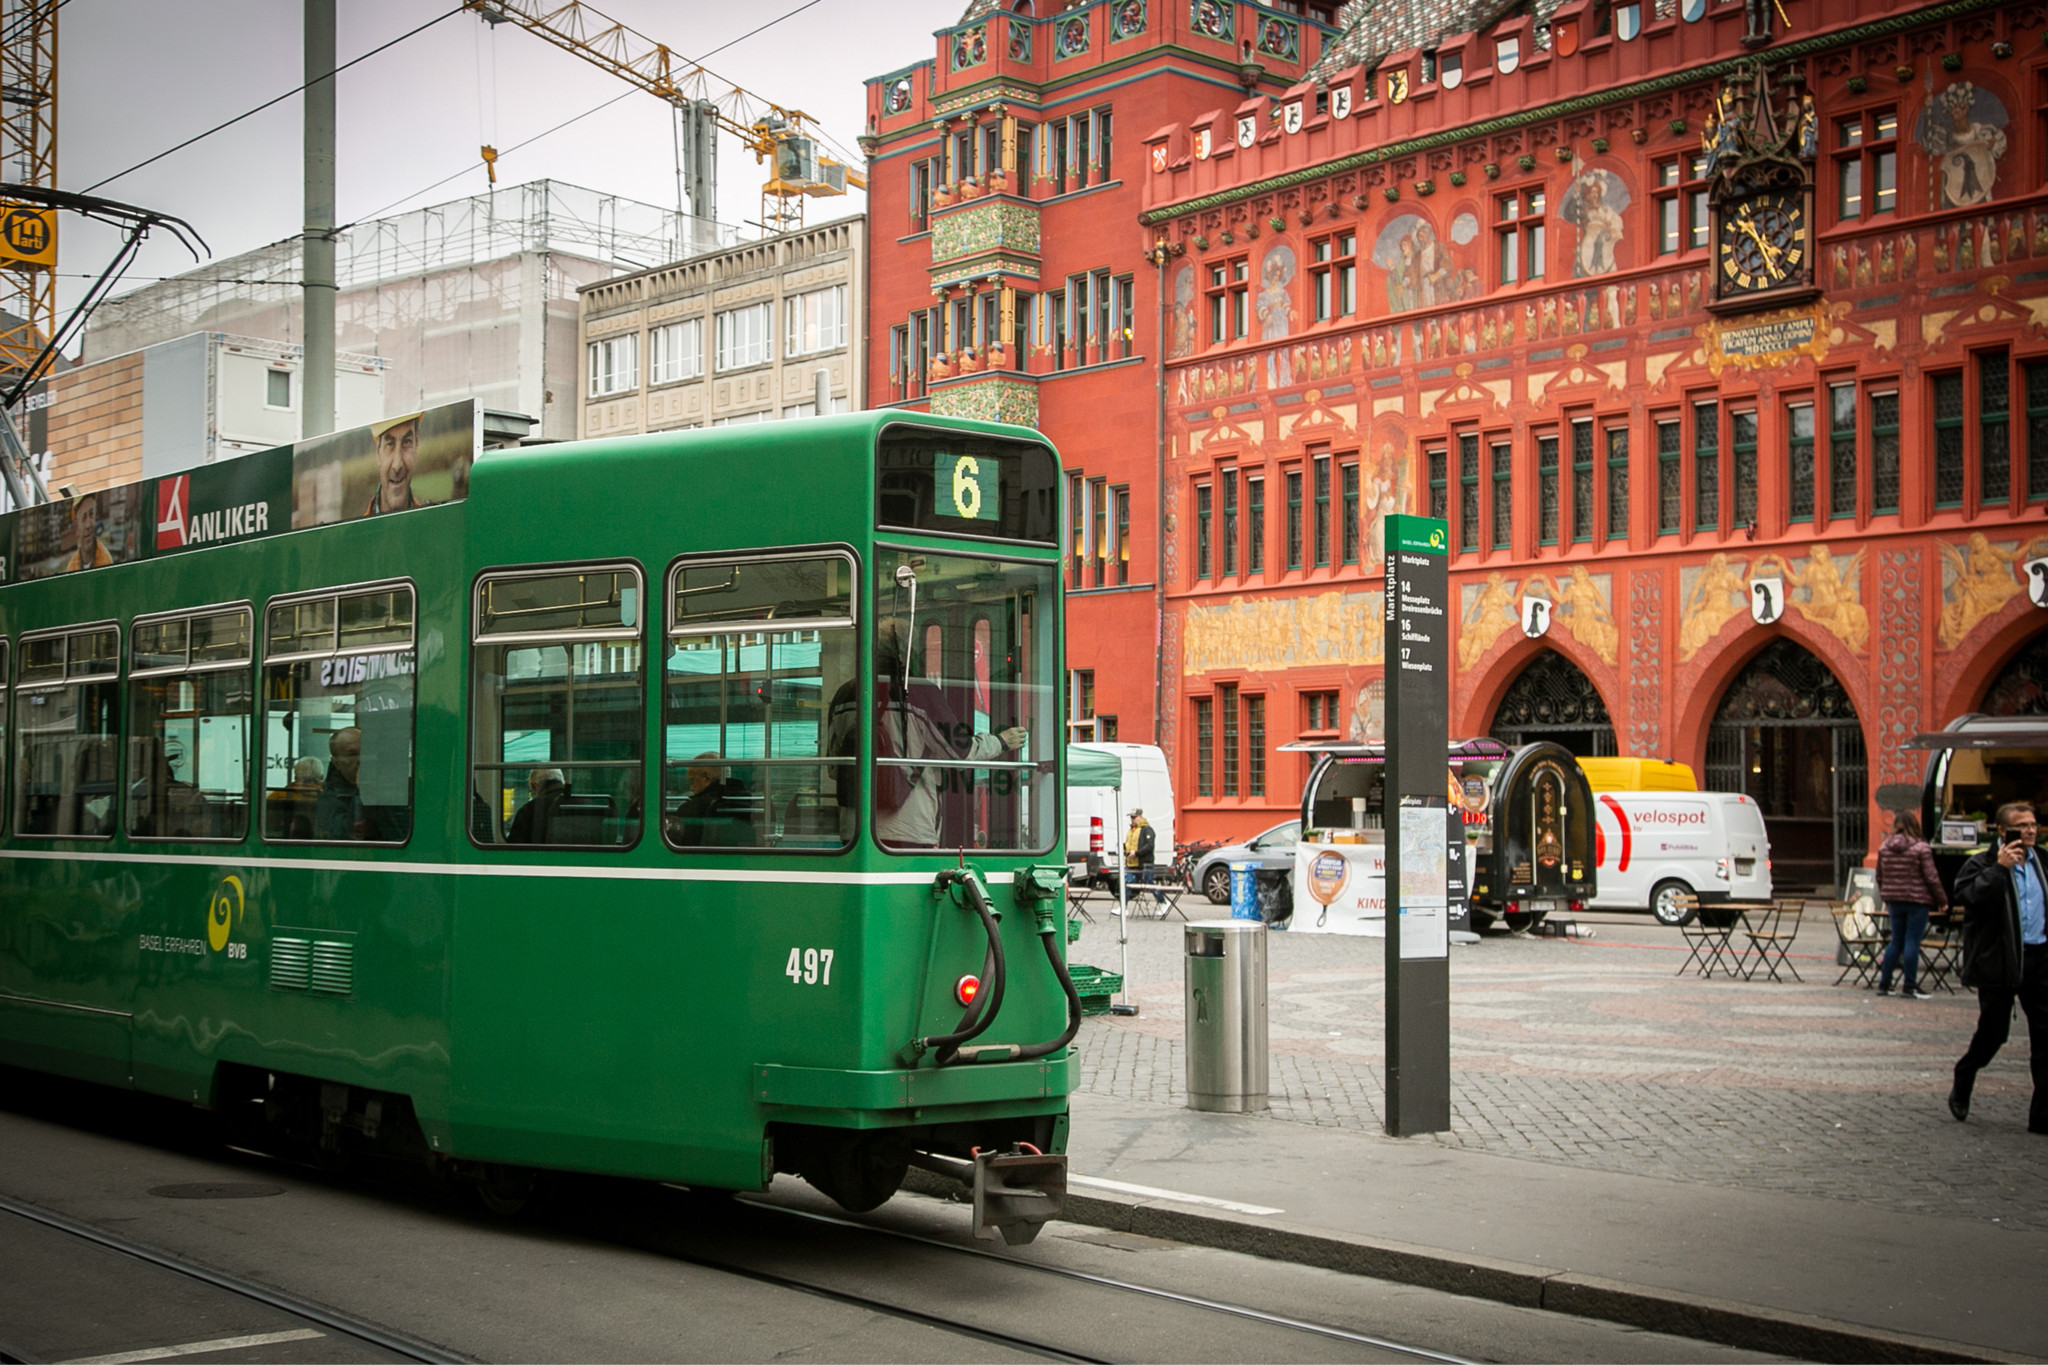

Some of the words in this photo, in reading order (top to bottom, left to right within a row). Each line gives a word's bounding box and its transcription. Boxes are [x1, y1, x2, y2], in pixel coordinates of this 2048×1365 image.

[953, 456, 981, 519] 6
[189, 501, 269, 545] ANLIKER
[1402, 555, 1430, 567] Marktplatz
[1386, 555, 1397, 621] Marktplatz
[1401, 580, 1411, 593] 14
[1402, 594, 1430, 606] Messeplatz
[1402, 604, 1443, 616] Dreirosenbrücke
[1401, 619, 1411, 631] 16
[1402, 632, 1431, 643] Schifflände
[1401, 648, 1411, 660] 17
[1402, 661, 1433, 672] Wiesenplatz
[1633, 810, 1706, 826] velospot
[140, 934, 164, 952] BASEL
[164, 937, 207, 956] ERFAHREN
[228, 942, 247, 959] BVB
[785, 947, 834, 986] 497
